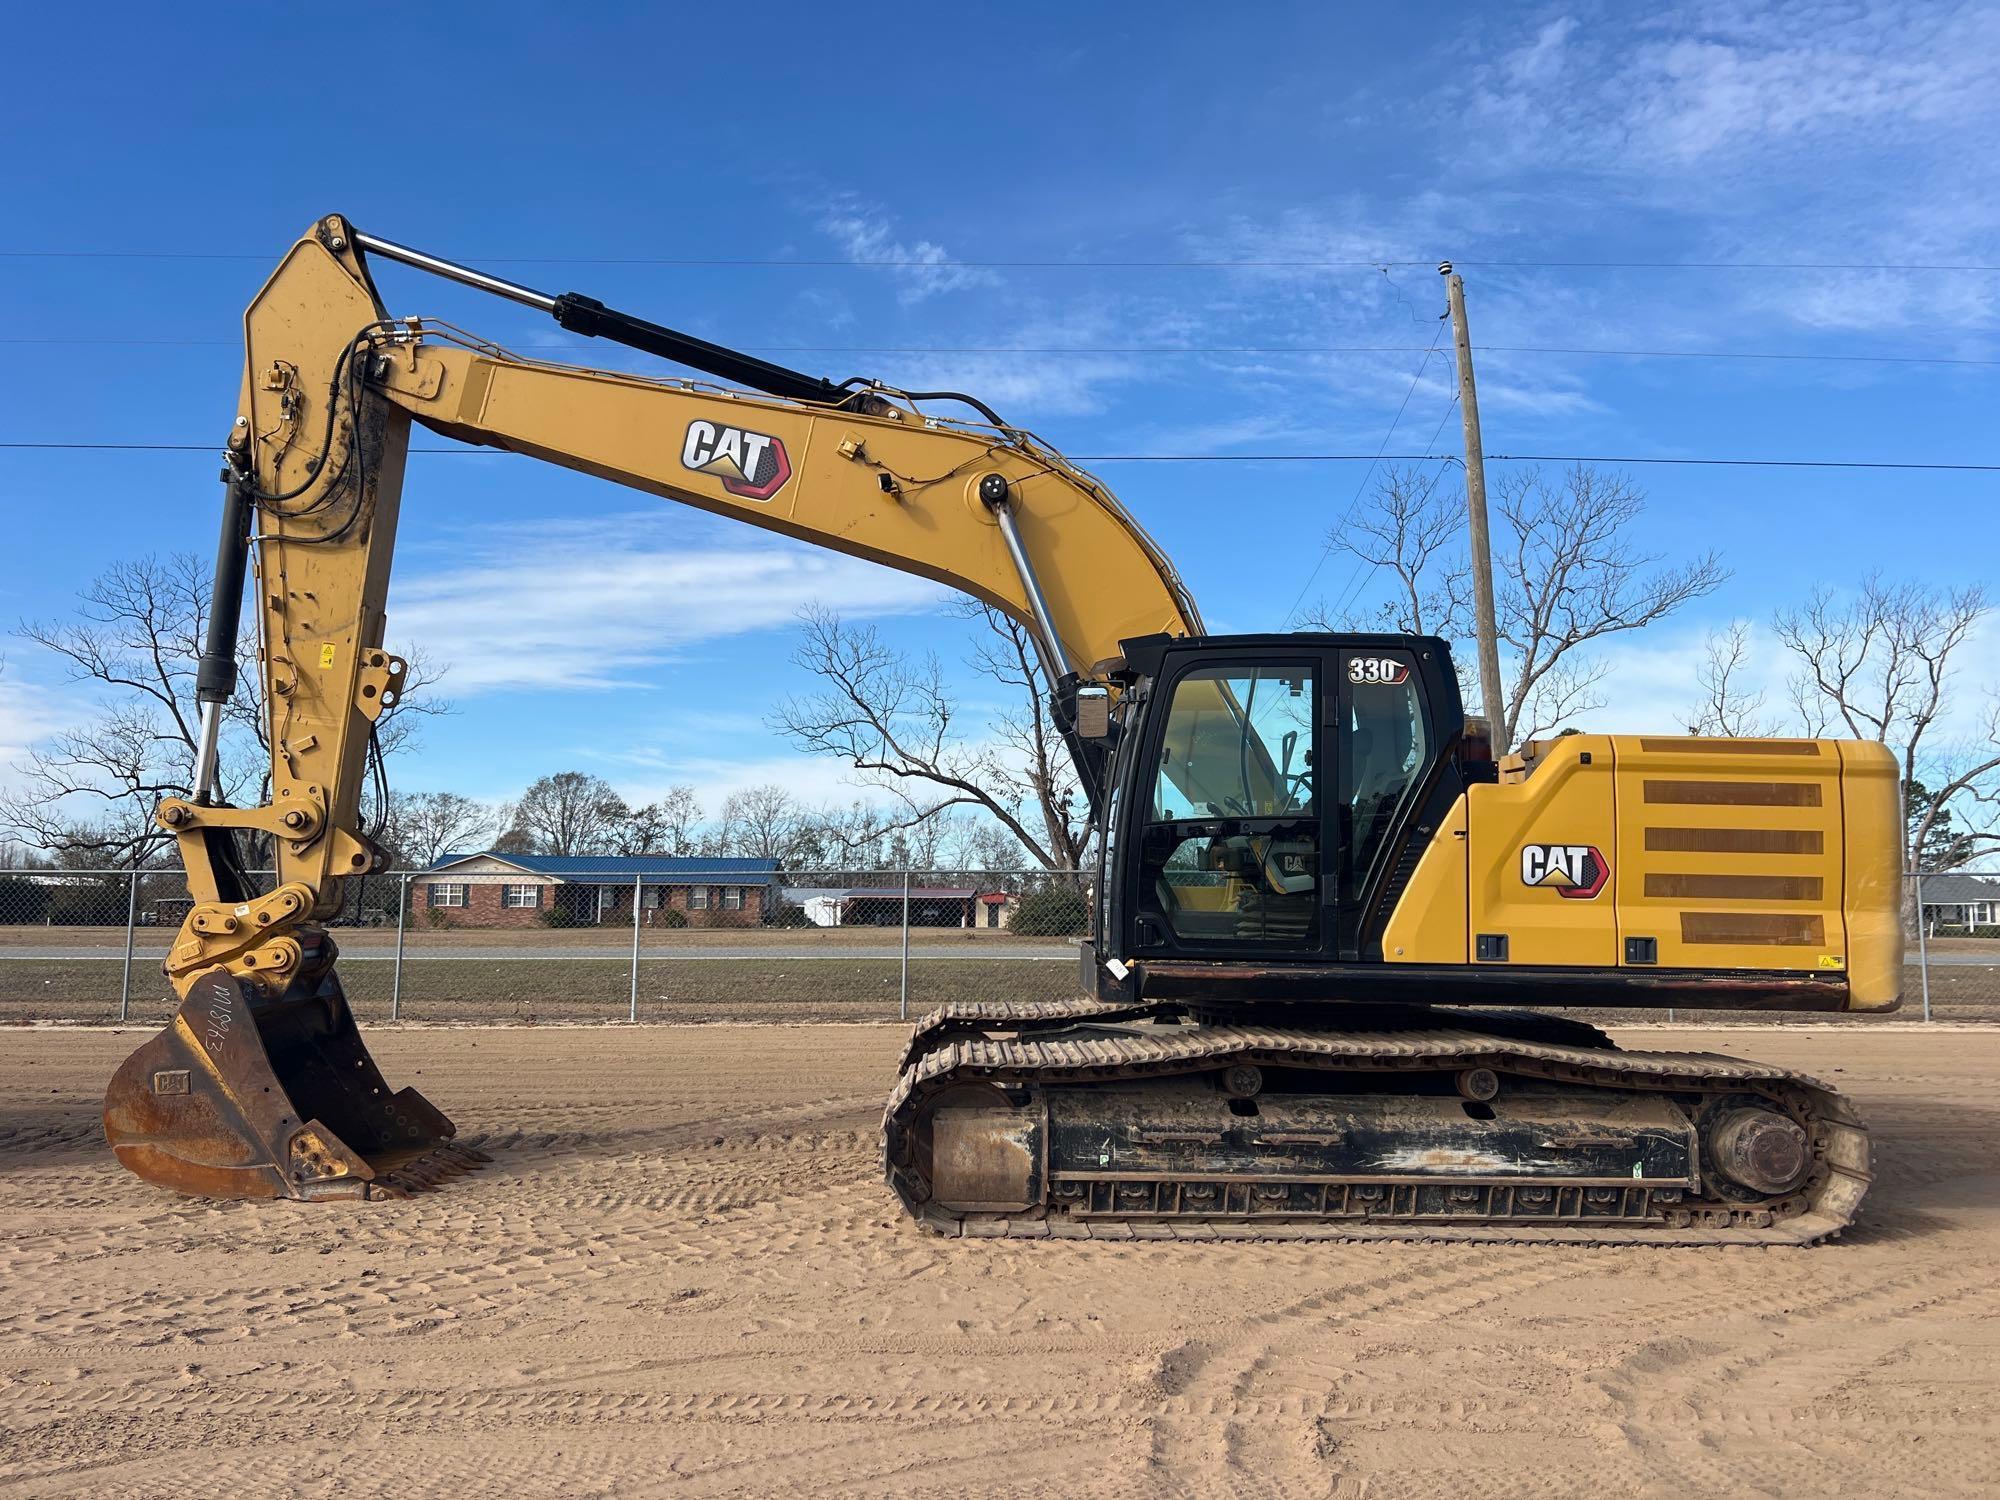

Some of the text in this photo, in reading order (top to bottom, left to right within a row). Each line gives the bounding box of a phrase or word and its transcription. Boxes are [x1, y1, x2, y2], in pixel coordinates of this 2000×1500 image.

[683, 420, 771, 483] CAT
[1350, 658, 1395, 682] 330
[1284, 856, 1305, 872] CA
[1522, 845, 1589, 886] CAT
